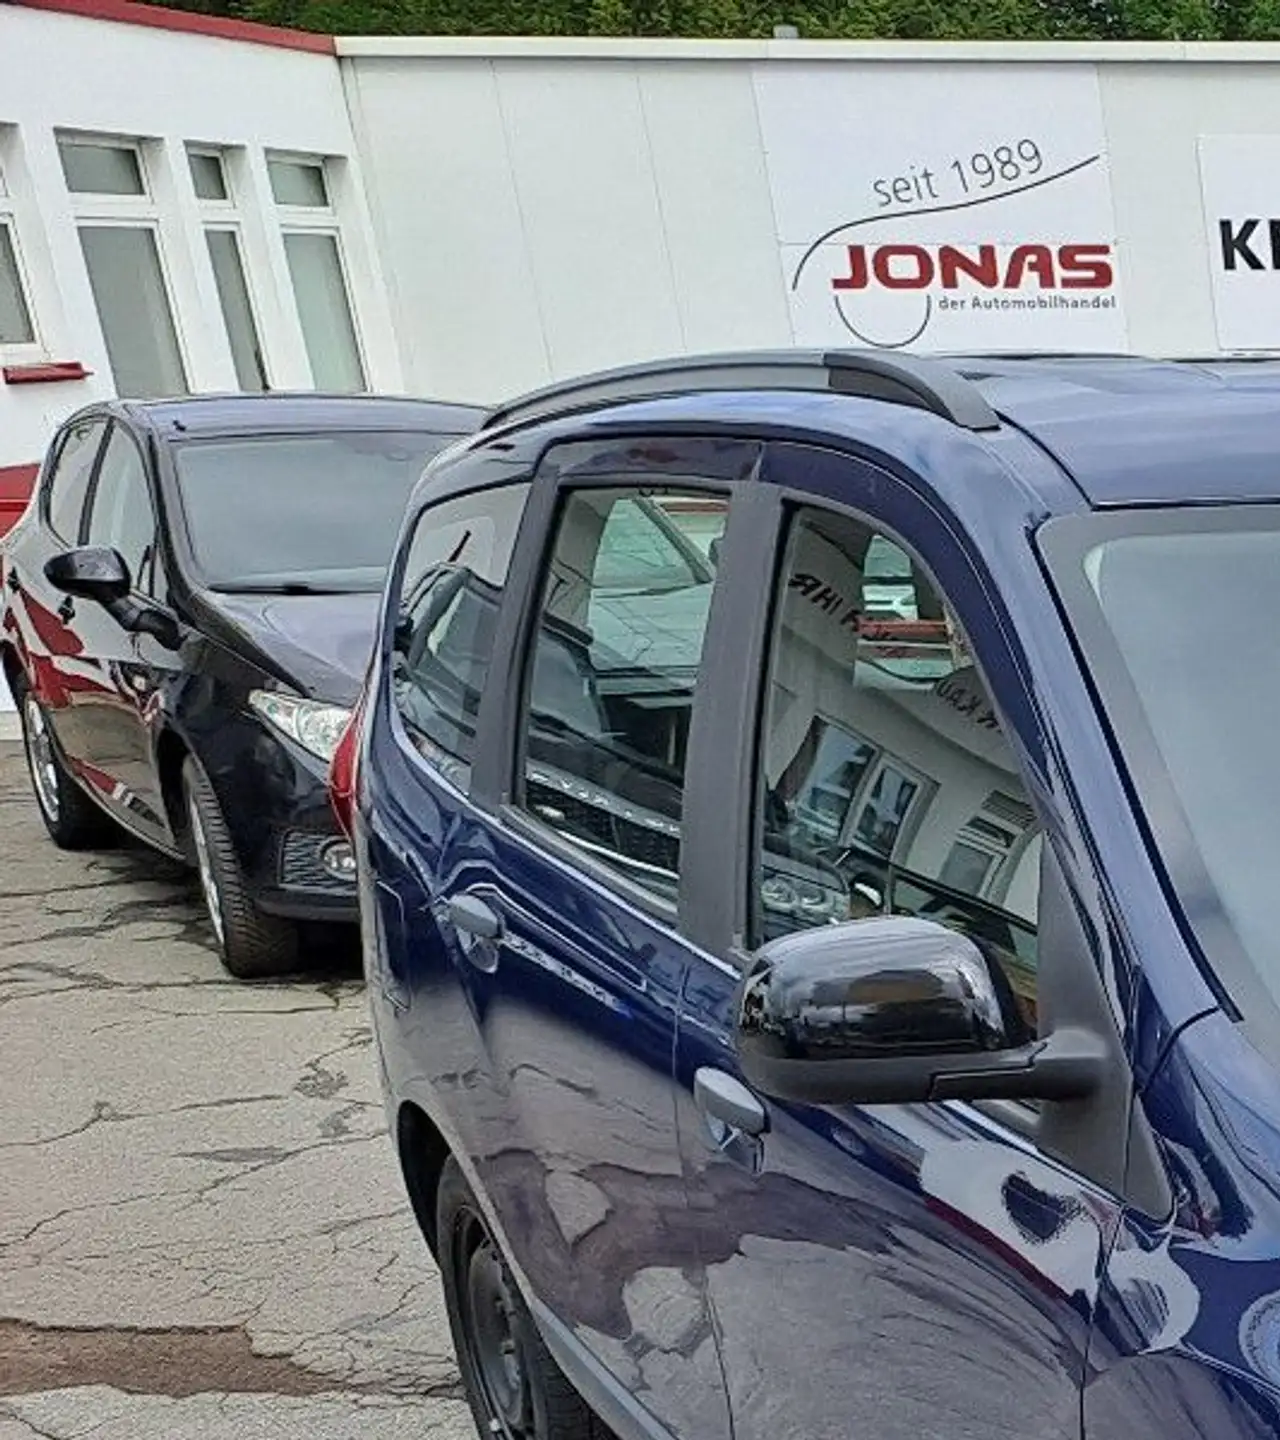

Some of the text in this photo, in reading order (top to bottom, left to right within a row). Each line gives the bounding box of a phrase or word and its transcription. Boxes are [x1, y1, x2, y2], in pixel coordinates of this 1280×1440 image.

[872, 138, 1043, 207] seit 1989
[832, 244, 1113, 290] JONAS
[938, 294, 1118, 310] der Automobilhandel
